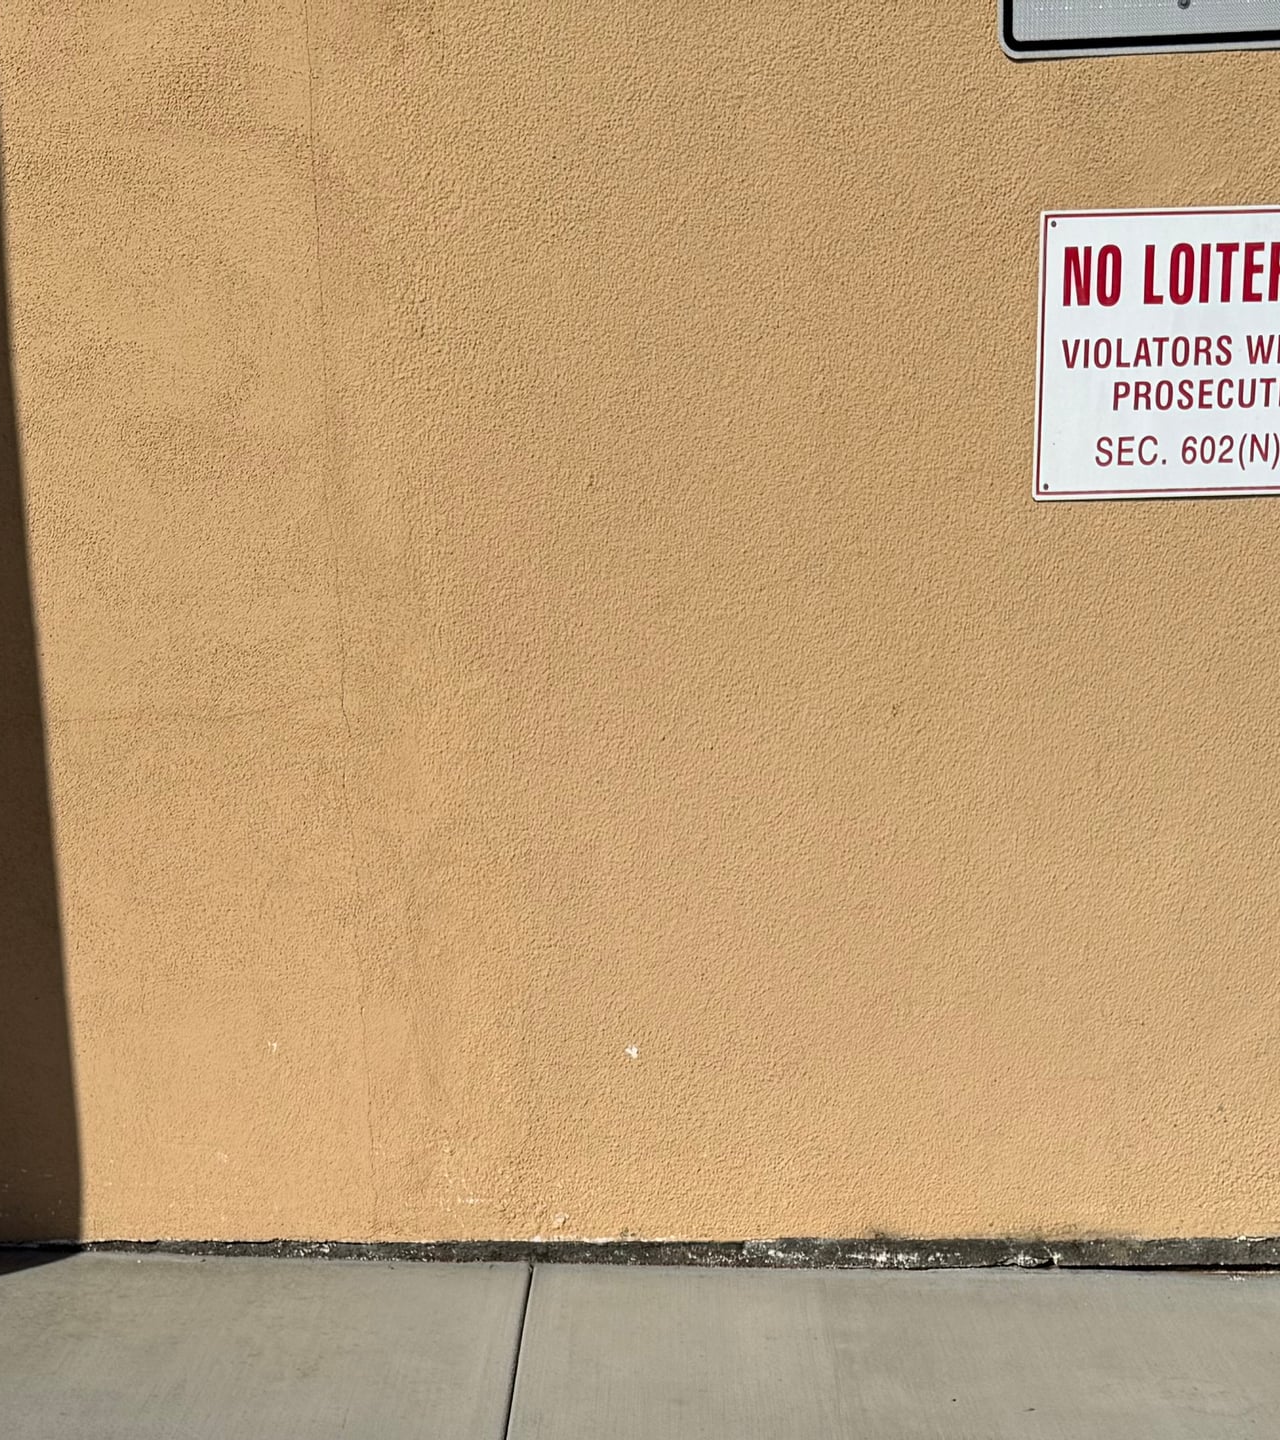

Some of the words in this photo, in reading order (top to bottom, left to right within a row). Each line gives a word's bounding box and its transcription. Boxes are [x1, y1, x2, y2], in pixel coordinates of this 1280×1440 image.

[1063, 244, 1122, 307] NO
[1063, 336, 1232, 368] VIOLATORS
[1096, 436, 1167, 467] SEC.
